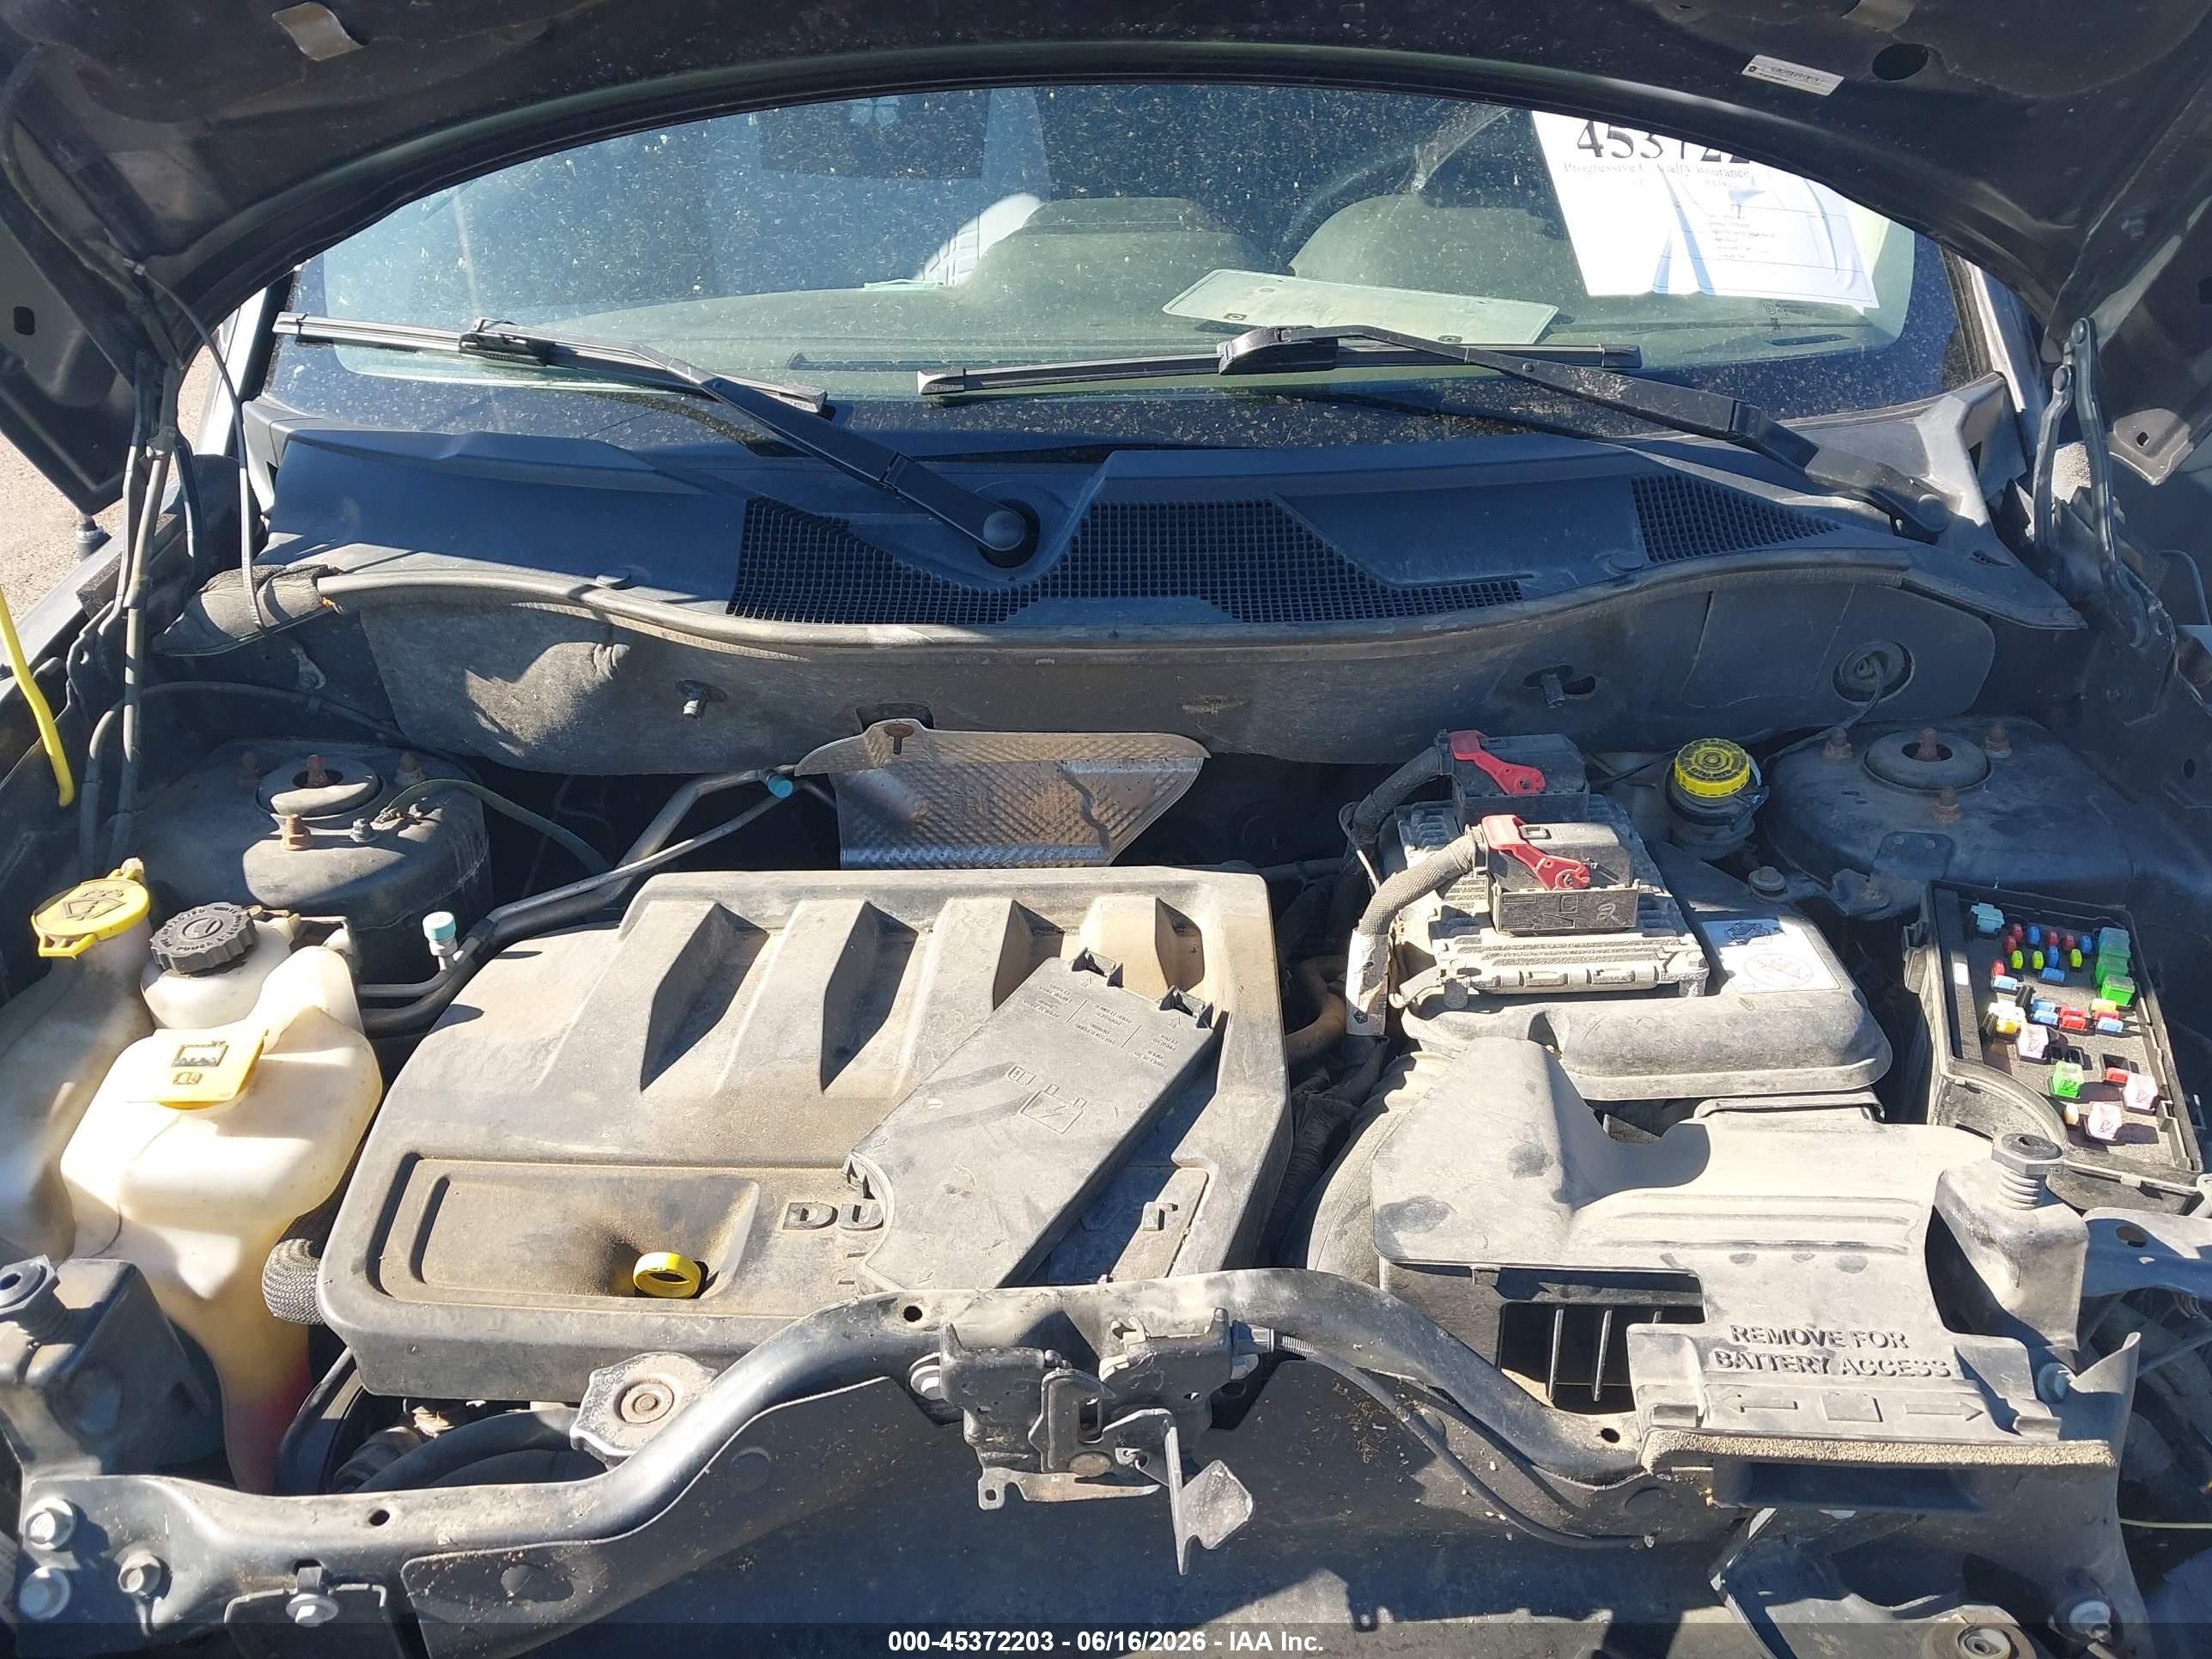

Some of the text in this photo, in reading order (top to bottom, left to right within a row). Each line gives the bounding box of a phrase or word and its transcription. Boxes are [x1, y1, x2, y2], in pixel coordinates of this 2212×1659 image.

[1729, 1324, 1909, 1349] REMOVE FOR
[1714, 1351, 1952, 1377] BATTERY ACCESS
